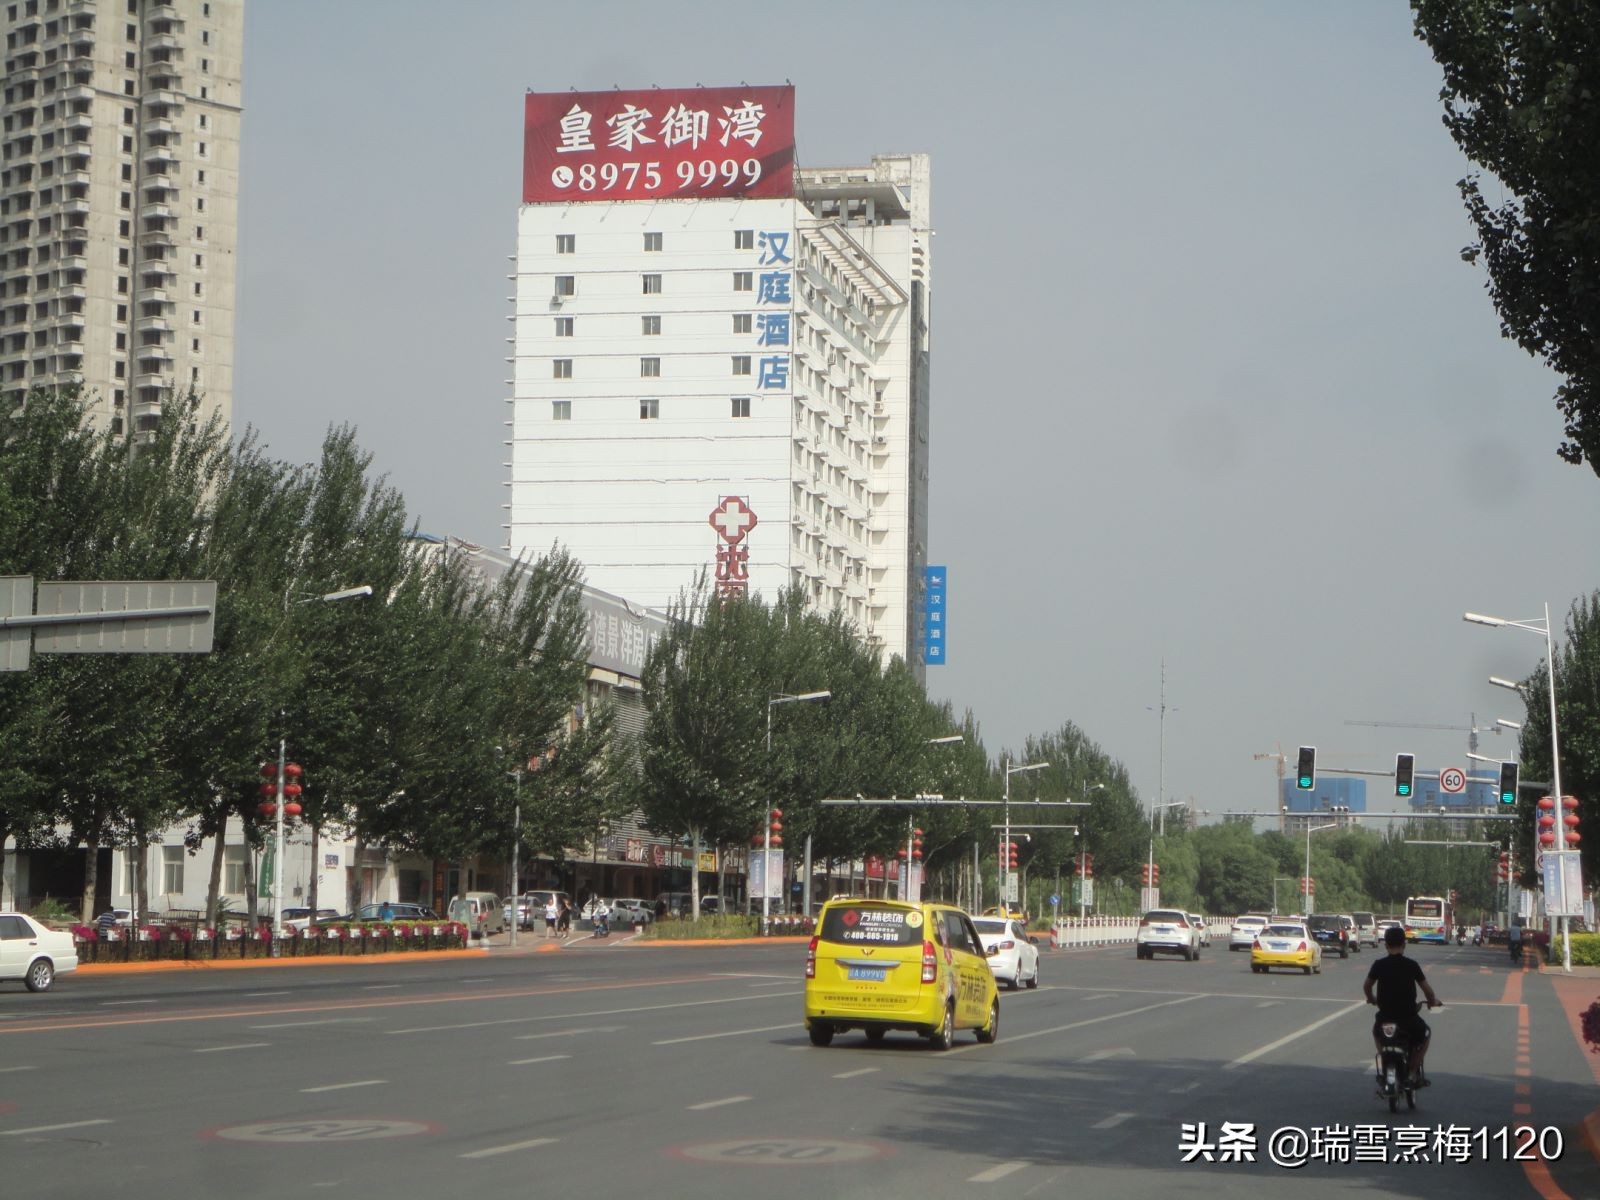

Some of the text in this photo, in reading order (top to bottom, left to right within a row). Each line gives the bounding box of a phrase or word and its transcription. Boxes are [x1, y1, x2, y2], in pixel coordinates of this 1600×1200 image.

[556, 100, 766, 153] 皇家御湾
[578, 158, 762, 191] 8975 9999
[756, 230, 792, 390] 汉庭酒店
[1445, 774, 1461, 786] 60
[860, 912, 904, 923] 方林装饰
[720, 1142, 839, 1160] 60
